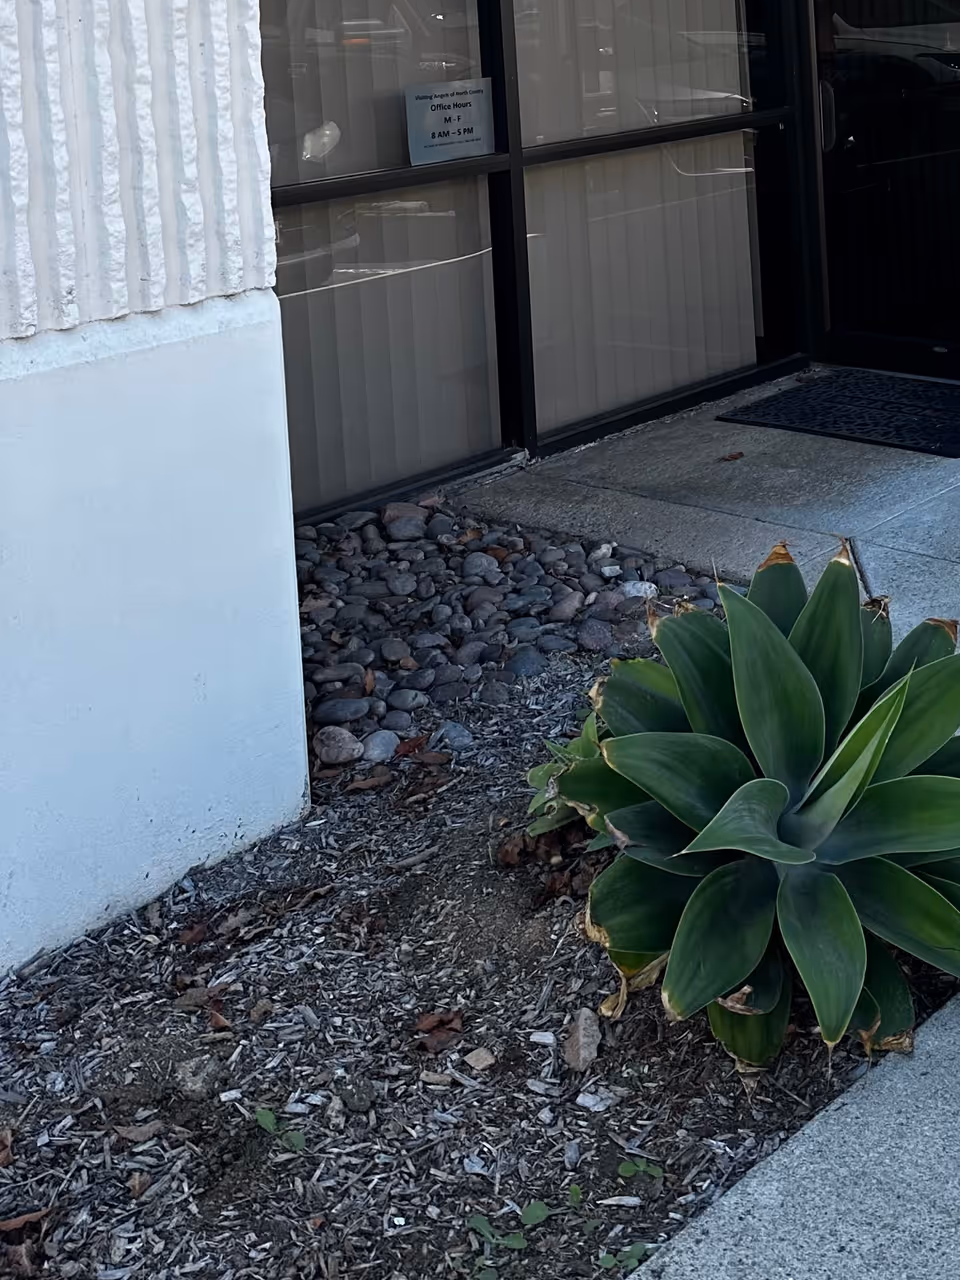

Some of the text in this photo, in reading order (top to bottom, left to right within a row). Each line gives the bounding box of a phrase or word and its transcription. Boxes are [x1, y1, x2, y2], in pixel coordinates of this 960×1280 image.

[431, 101, 472, 111] Office Hours
[444, 116, 452, 124] M
[437, 130, 450, 138] AM
